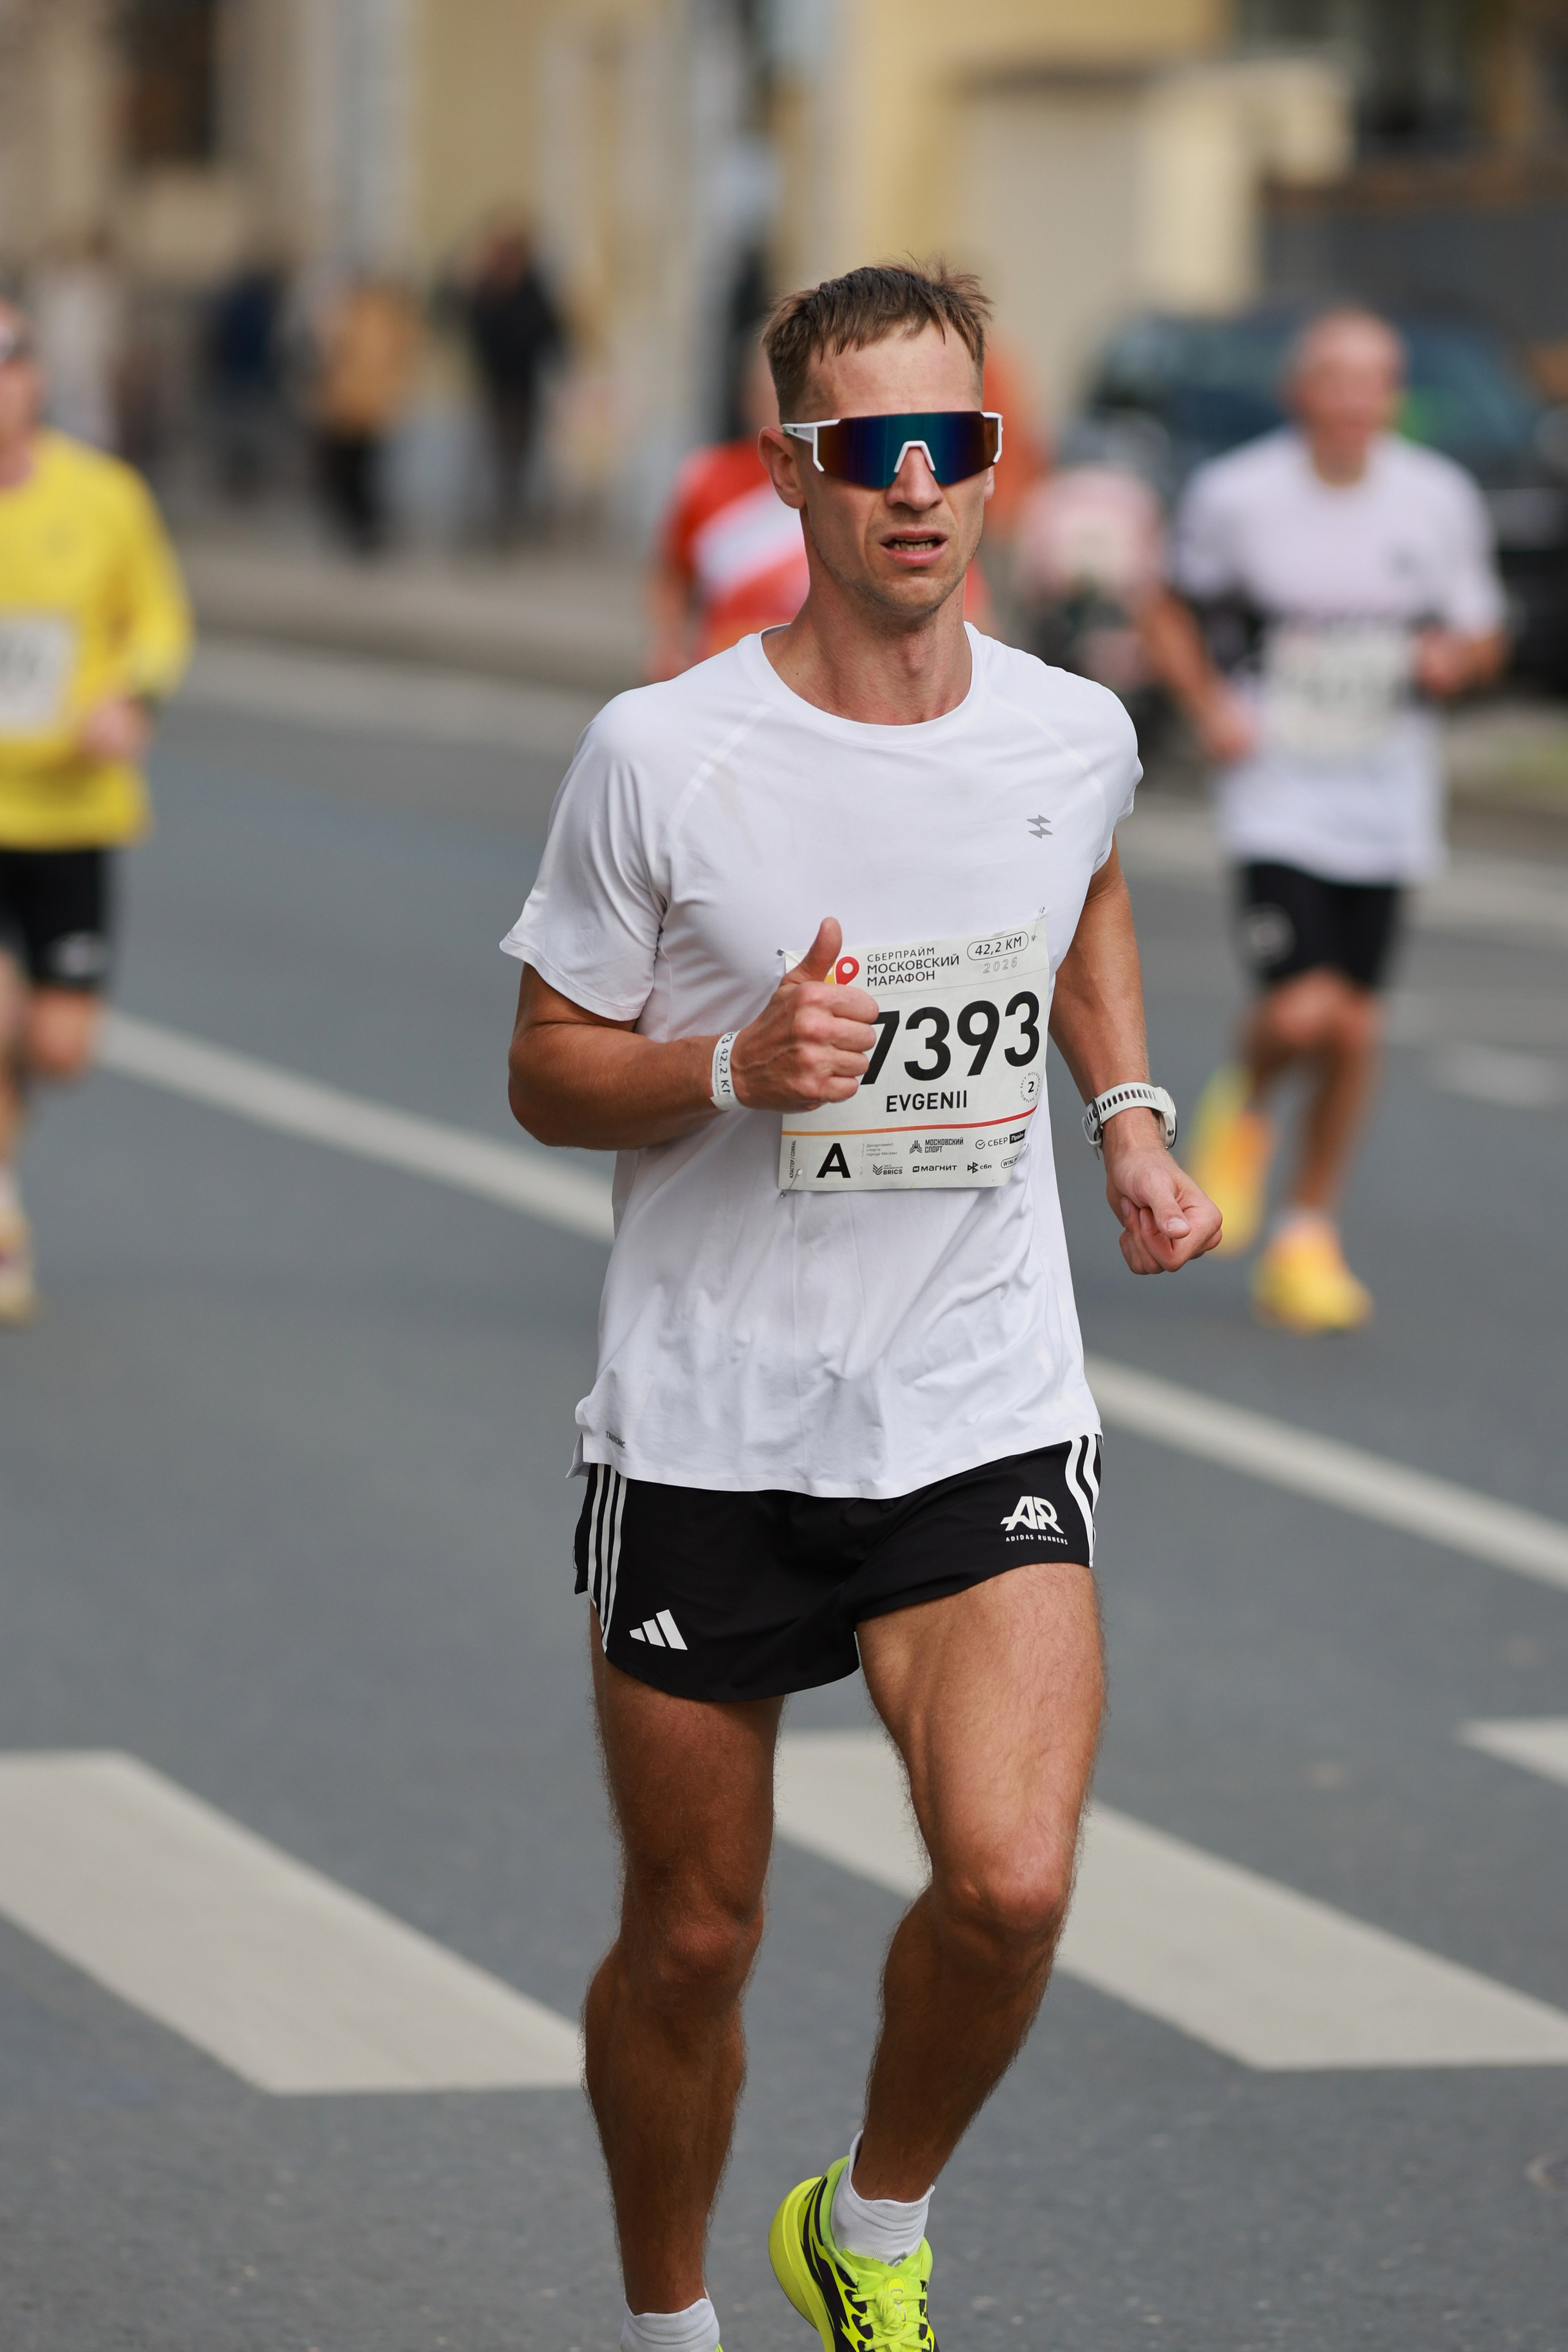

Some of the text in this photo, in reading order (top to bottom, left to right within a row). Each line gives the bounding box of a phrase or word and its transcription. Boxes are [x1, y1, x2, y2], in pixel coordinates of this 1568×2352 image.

[867, 947, 935, 962] СБЕРПРАЙМ
[975, 942, 1001, 955] 42,2
[867, 953, 960, 974] МОСКОВСКИЙ
[983, 957, 1017, 973] 2026
[867, 970, 935, 987] МАРАФОН
[719, 1048, 729, 1074] 42,2
[1028, 1081, 1035, 1093] 2
[886, 1090, 967, 1112] EVGENII
[925, 1136, 963, 1146] МОСКОВСКИЙ
[988, 1137, 1008, 1147] СБЕР
[1038, 1534, 1068, 1545] RUNNERS
